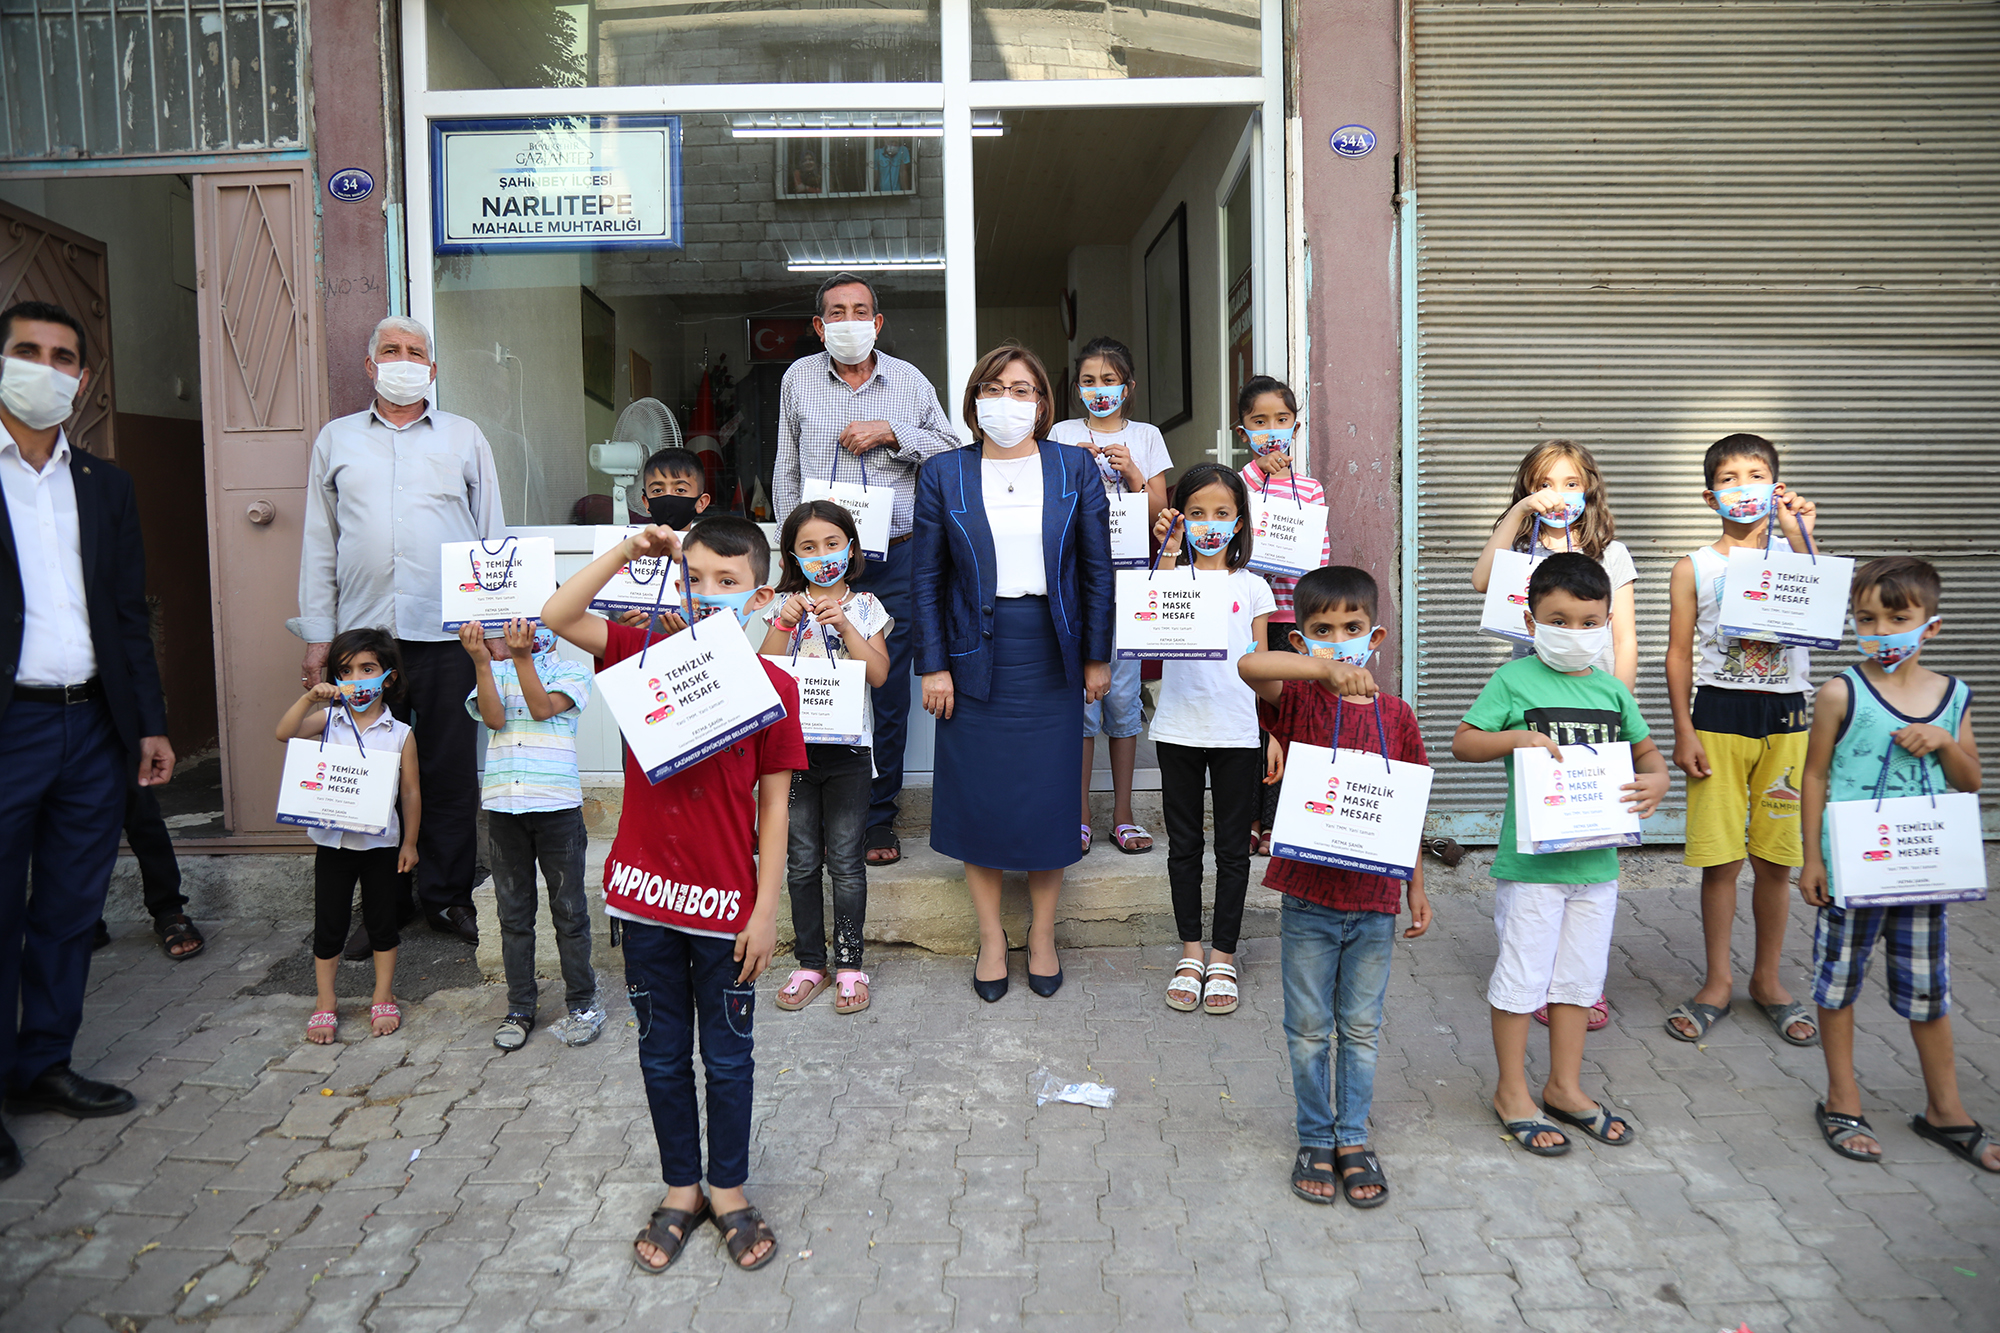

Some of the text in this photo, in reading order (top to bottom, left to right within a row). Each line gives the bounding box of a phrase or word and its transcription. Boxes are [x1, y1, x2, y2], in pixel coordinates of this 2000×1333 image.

[1340, 135, 1367, 147] 34A
[343, 178, 359, 191] 34
[499, 173, 613, 188] ŞAHİNBEY İLÇESİ
[482, 194, 633, 217] NARLITEPE
[472, 216, 642, 235] MAHALLE MUHTARLIĞI
[1273, 514, 1304, 526] TEMİZLİK
[1271, 524, 1295, 533] MASKE
[1270, 532, 1297, 542] MESAFE
[486, 558, 522, 568] TEMİZLİK
[634, 568, 665, 576] MESAFE
[1778, 573, 1820, 584] TEMİZLİK
[1163, 590, 1201, 598] TEMİZLİK
[1776, 584, 1807, 594] MASKE
[1774, 594, 1810, 605] MESAFE
[665, 651, 714, 681] TEMİZLİK
[672, 670, 709, 694] MASKE
[805, 677, 840, 686] TEMİZLİK
[679, 680, 721, 707] MESAFE
[803, 698, 833, 706] MESAFE
[331, 765, 369, 776] TEMİZLİK
[1567, 767, 1606, 778] TEMİZLİK
[330, 775, 358, 785] MASKE
[1569, 781, 1598, 790] MASKE
[328, 785, 360, 795] MESAFE
[1346, 781, 1394, 798] TEMİZLİK
[1343, 795, 1380, 809] MASKE
[1571, 792, 1603, 802] MESAFE
[1340, 807, 1382, 823] MESAFE
[1895, 820, 1945, 833] TEMİZLİK
[1348, 841, 1363, 849] ŞAHİN
[1897, 835, 1934, 845] MASKE
[1898, 847, 1940, 857] MESAFE
[1298, 851, 1327, 861] GAZİANTEP
[1327, 855, 1358, 868] BÜYÜKŞEHİR
[1358, 862, 1386, 873] BELEDİYESİ
[608, 860, 680, 910] MPION
[683, 884, 741, 921] BOYS
